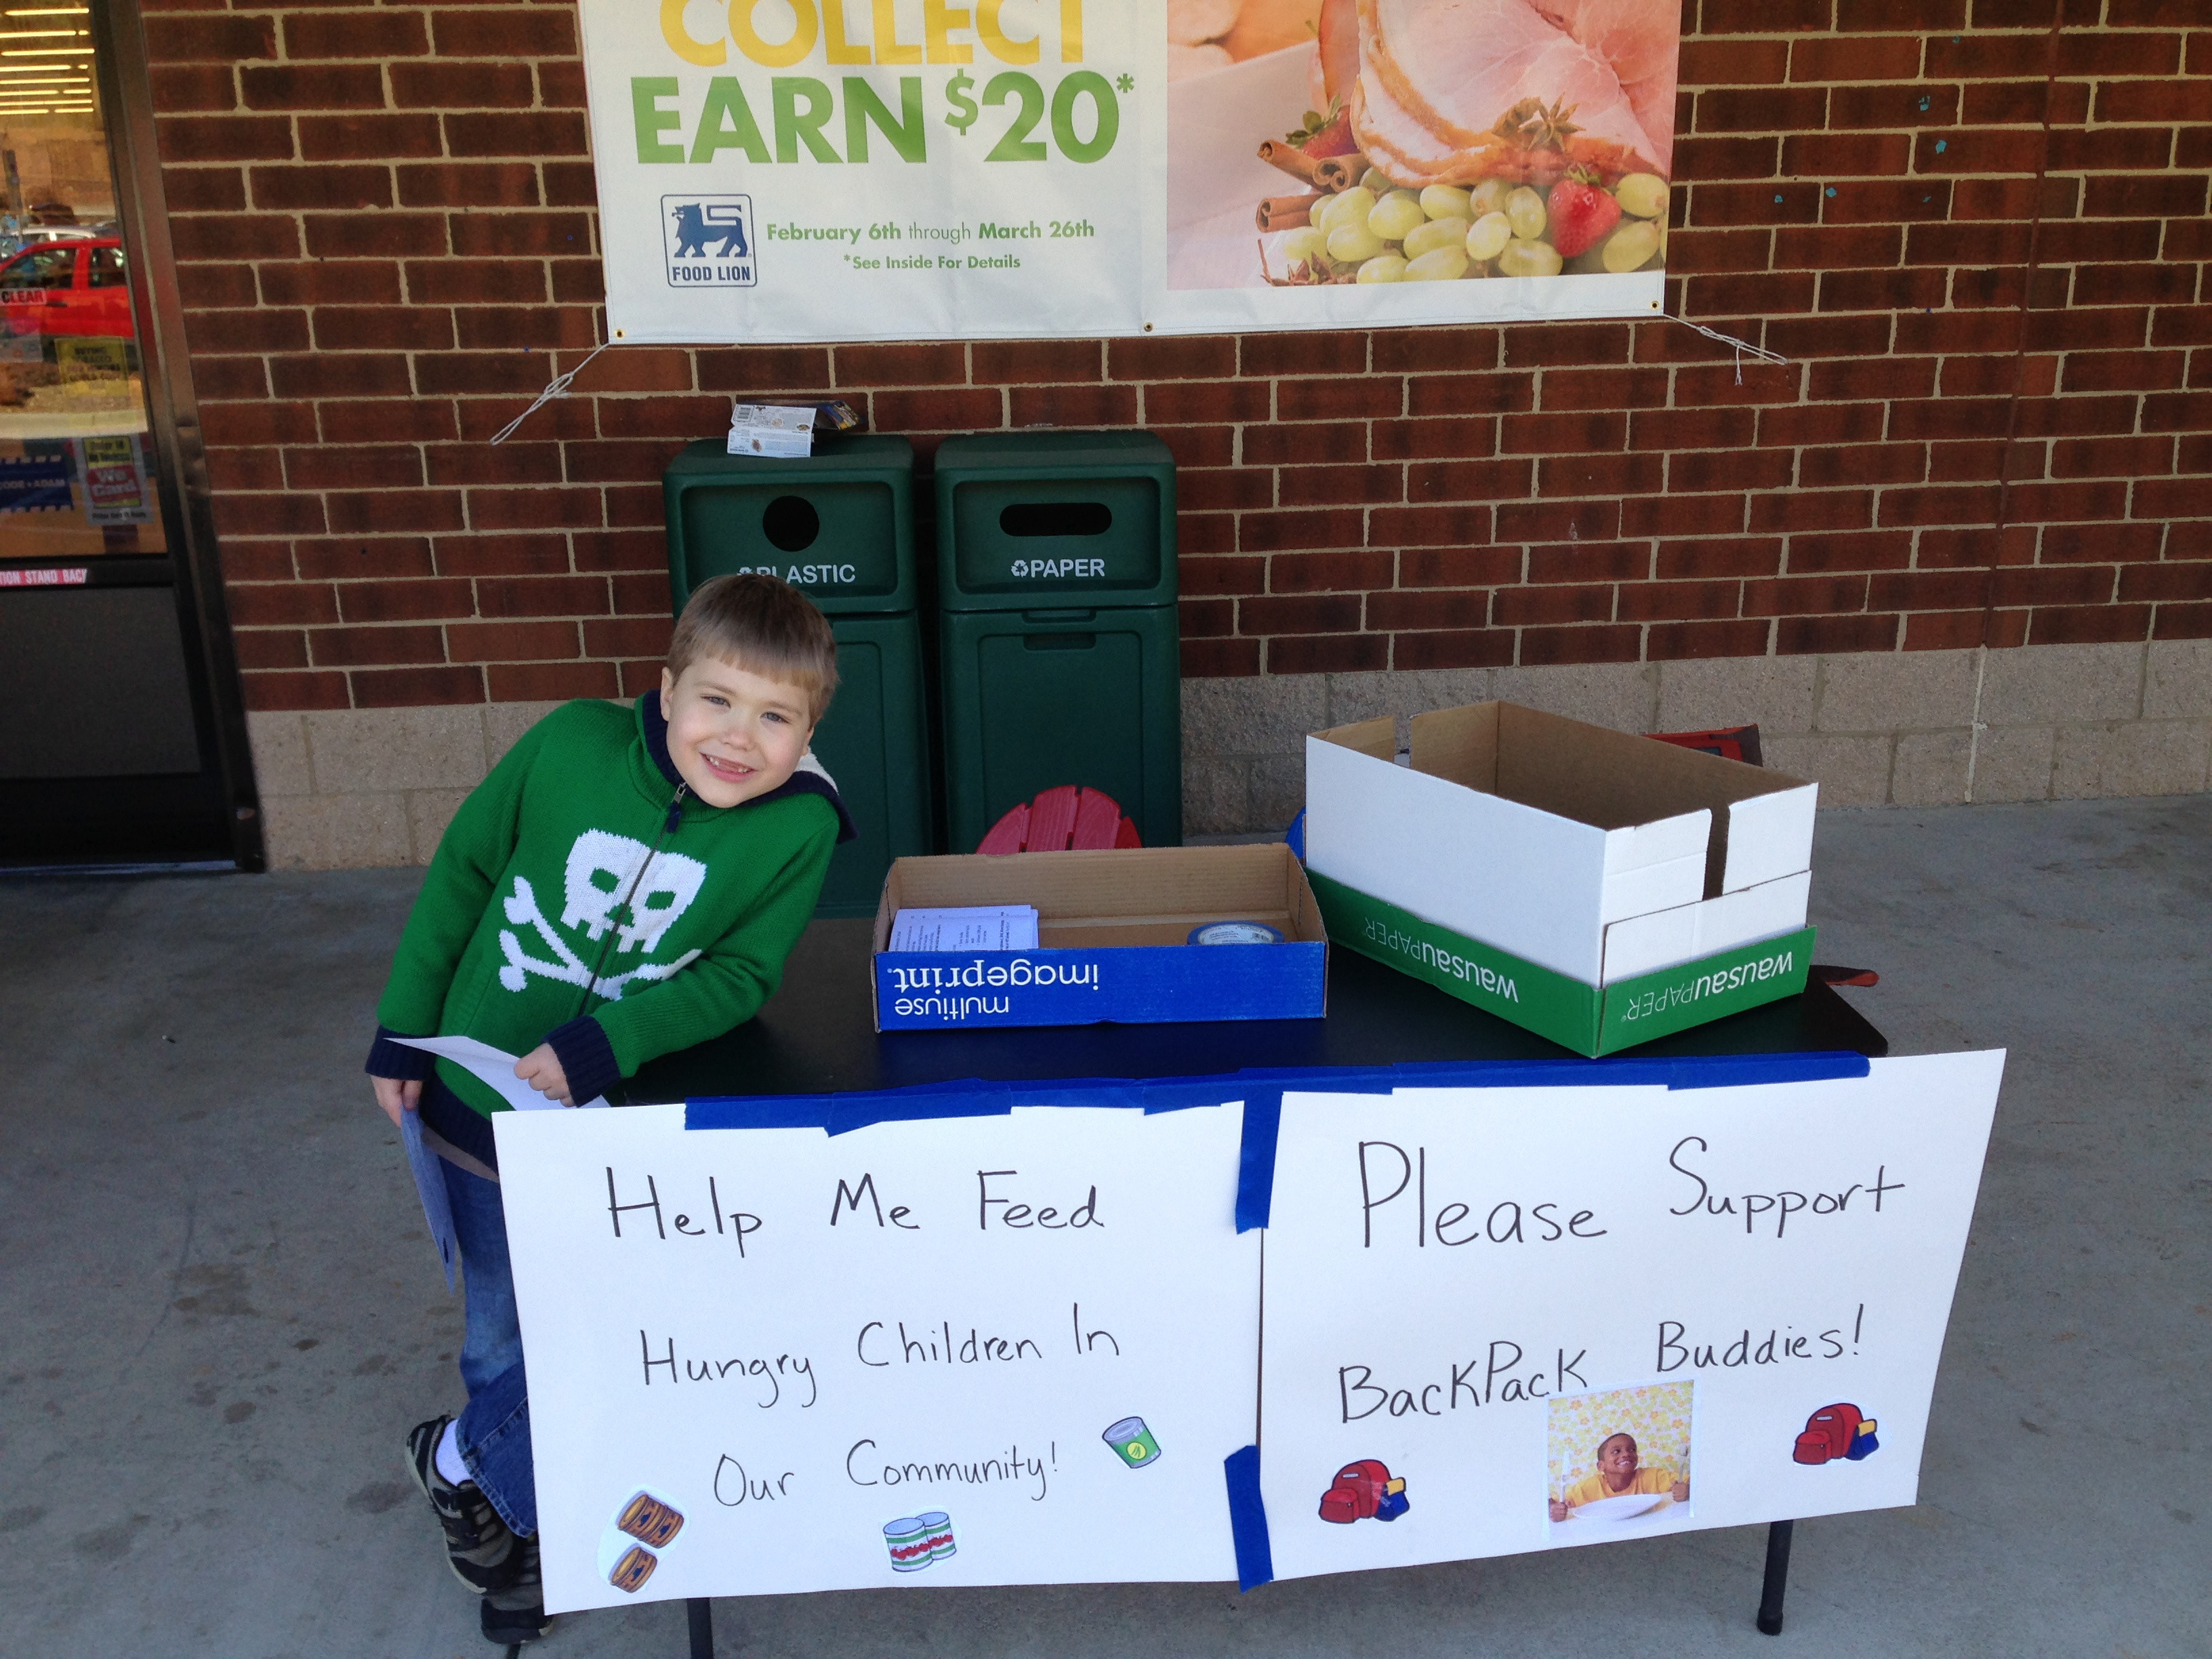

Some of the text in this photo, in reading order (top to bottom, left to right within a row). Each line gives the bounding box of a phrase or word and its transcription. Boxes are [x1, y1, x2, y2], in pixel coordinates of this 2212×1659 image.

[659, 0, 1084, 68] COLLECT
[630, 76, 927, 164] EARN
[766, 220, 1095, 245] February 6th through March 26th
[672, 266, 751, 281] FOOD LION
[886, 255, 933, 269] Inside
[938, 255, 962, 269] For
[968, 255, 1021, 270] Details
[1, 291, 43, 303] CLEAR
[25, 569, 58, 584] STAND
[1031, 558, 1105, 578] PAPER
[895, 996, 1009, 1020] multiuse
[606, 1166, 1105, 1258] Help Me Feed
[1358, 1136, 1906, 1248] Please Support
[640, 1303, 1120, 1409] Hungry Children In
[1657, 1303, 1864, 1373] Buddies!
[714, 1439, 1058, 1507] Our Community!
